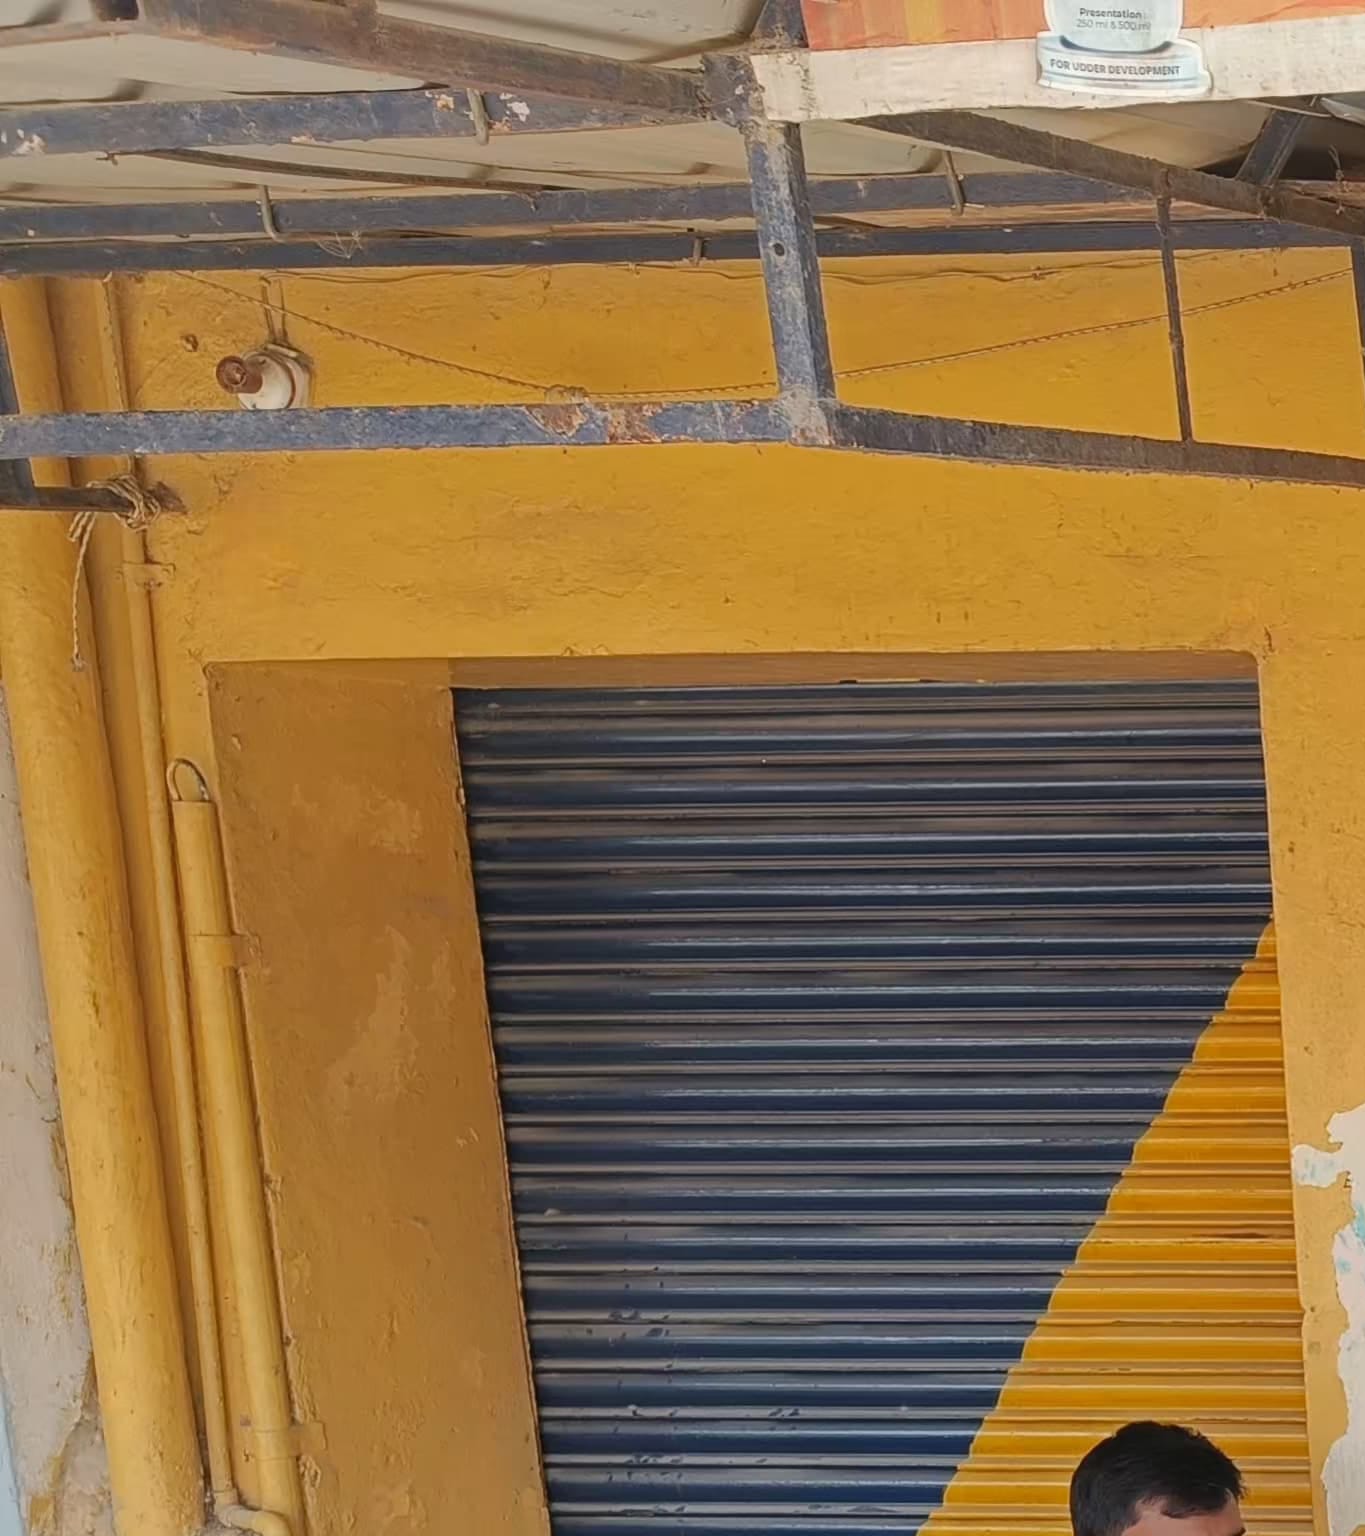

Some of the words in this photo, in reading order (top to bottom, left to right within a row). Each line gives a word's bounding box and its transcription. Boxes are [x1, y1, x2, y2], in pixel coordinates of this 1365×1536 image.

[1079, 7, 1142, 19] Presentation
[1050, 59, 1070, 71] FOR
[1072, 62, 1106, 74] UDDER
[1108, 64, 1181, 76] DEVELOPMENT
